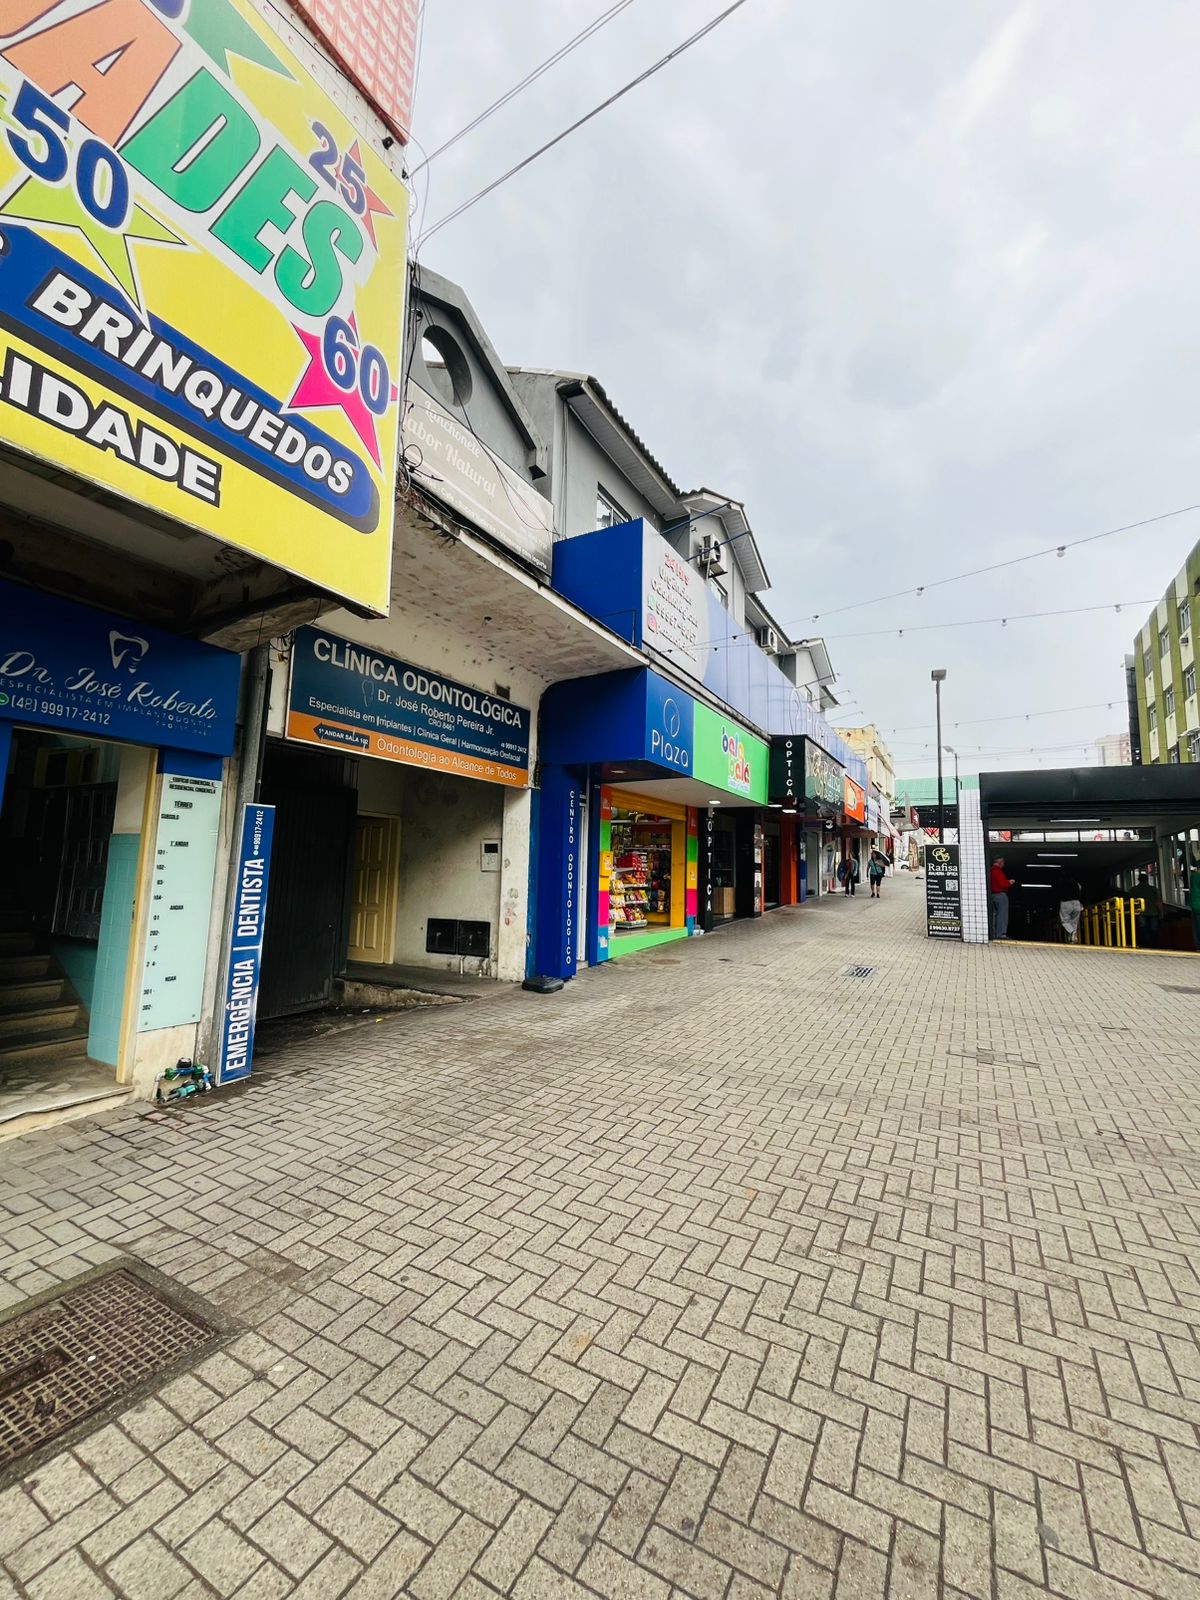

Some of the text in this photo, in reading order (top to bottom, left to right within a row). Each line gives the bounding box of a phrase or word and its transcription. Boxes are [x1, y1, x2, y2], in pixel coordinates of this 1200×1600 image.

[6, 80, 130, 229] 50
[309, 121, 366, 216] 25
[31, 272, 354, 494] BRINQUEDOS
[323, 316, 389, 415] 60
[0, 355, 219, 505] IDADE
[0, 651, 218, 720] Dr. José Roberto
[0, 678, 92, 704] ESPECIALISTA
[11, 695, 111, 725] (48) 99917-2412
[313, 638, 522, 729] CLÍNICA ODONTOLÓGICA
[309, 696, 360, 719] Especialista
[362, 713, 375, 723] em
[376, 715, 412, 734] Implantes
[440, 733, 458, 745] Geral
[324, 730, 345, 739] ANDAR
[345, 734, 360, 743] SALA
[378, 688, 495, 737] Dr. José Roberto Pereira Jr.
[428, 718, 442, 728] CRO
[377, 737, 518, 781] Odontologia ao Alcance de Todos
[652, 729, 689, 768] Plaza
[785, 740, 794, 796] ÓPTICA
[928, 863, 958, 871] Rafisa
[237, 858, 265, 937] DENTISTA
[225, 958, 255, 1072] EMERGÊNCIA
